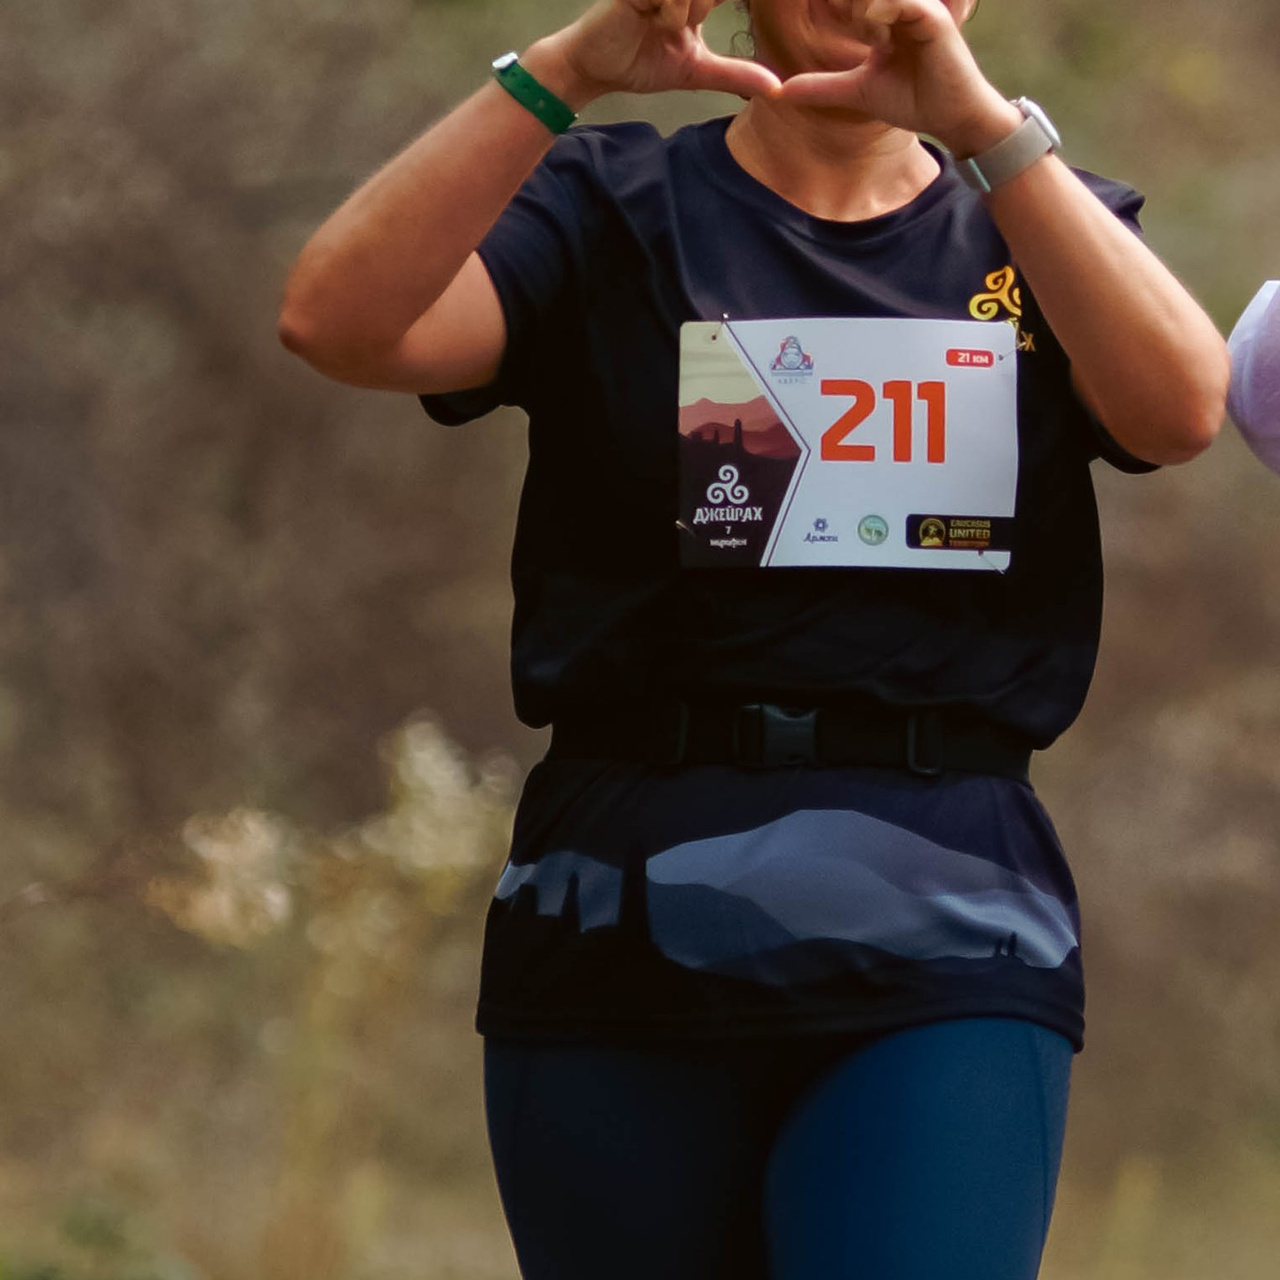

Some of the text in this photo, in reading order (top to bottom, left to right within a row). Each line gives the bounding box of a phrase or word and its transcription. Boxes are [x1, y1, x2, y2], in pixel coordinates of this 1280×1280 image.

[957, 352, 970, 363] 21
[820, 379, 945, 463] 211
[693, 505, 763, 524] ДЖЕЙРАХ
[725, 525, 732, 535] 7
[949, 528, 991, 539] UNITED
